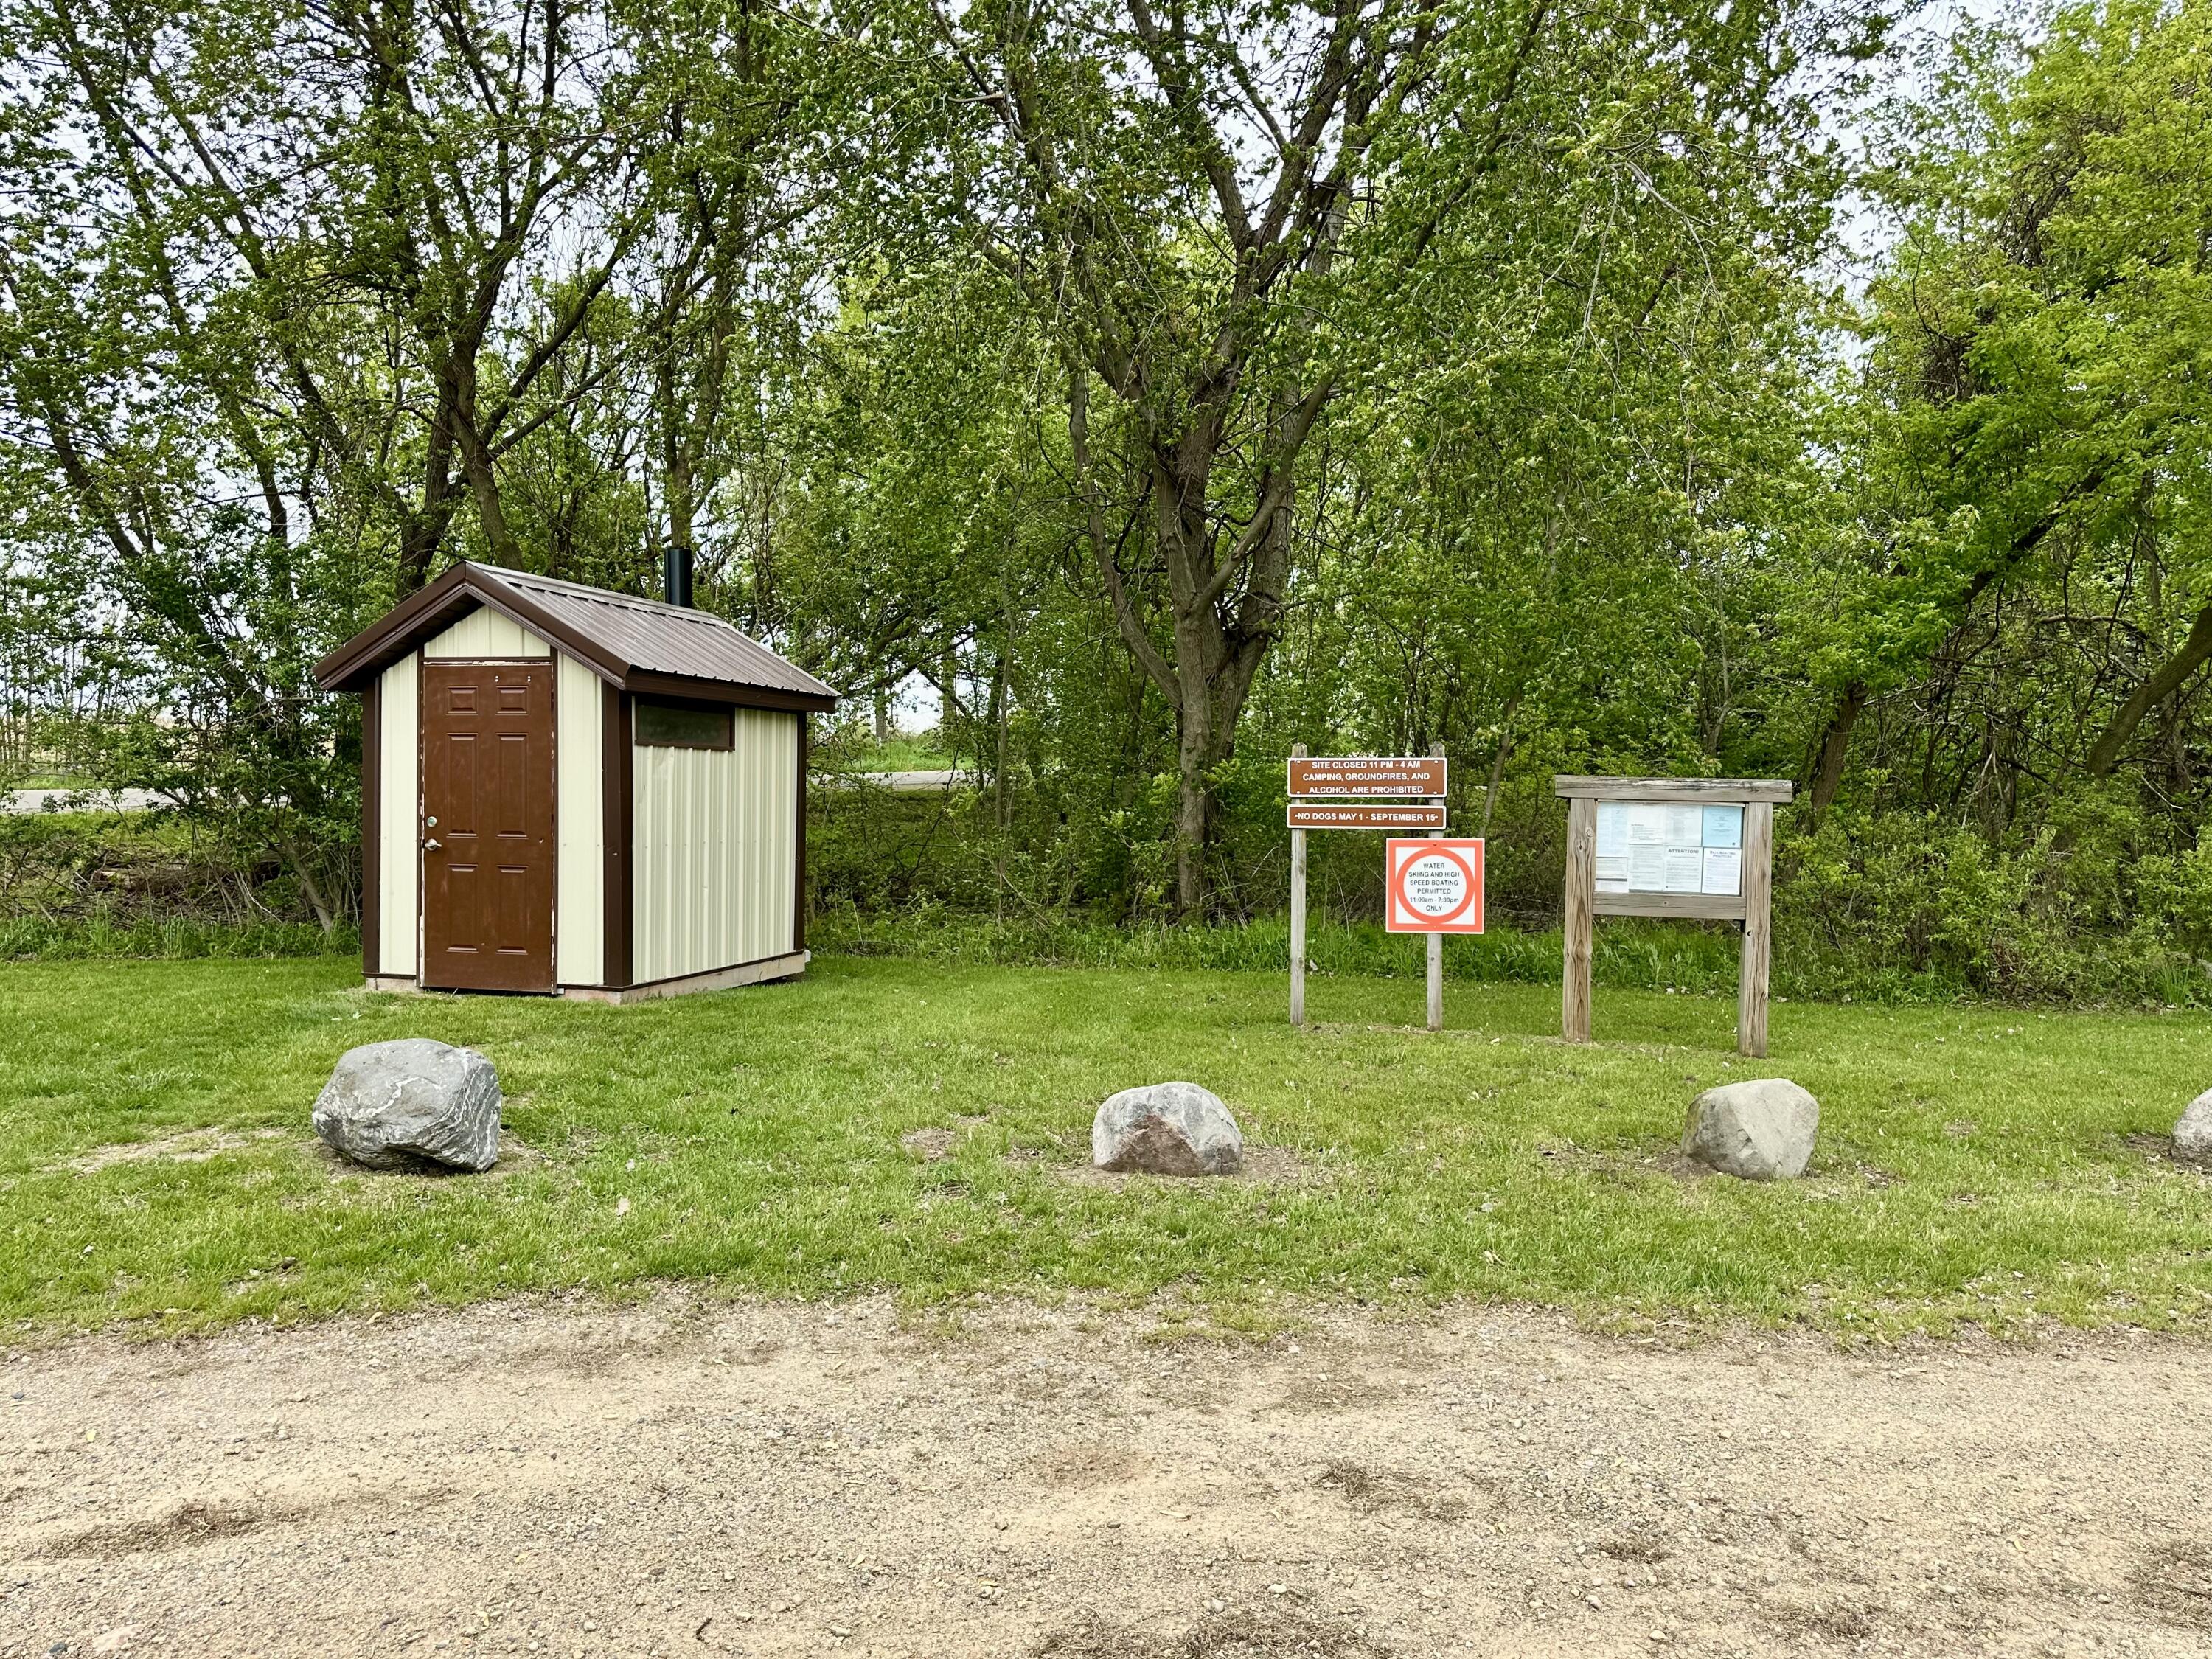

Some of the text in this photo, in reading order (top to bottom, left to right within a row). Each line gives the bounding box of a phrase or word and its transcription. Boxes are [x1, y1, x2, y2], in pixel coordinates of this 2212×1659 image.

[1312, 761, 1331, 769] SITE
[1332, 761, 1367, 769] CLOSED
[1302, 773, 1344, 782] CAMPING,
[1345, 773, 1409, 782] GROUNDFIRES,
[1309, 786, 1350, 794] ALCOHOL
[1351, 786, 1369, 794] ARE
[1425, 813, 1436, 821] 15
